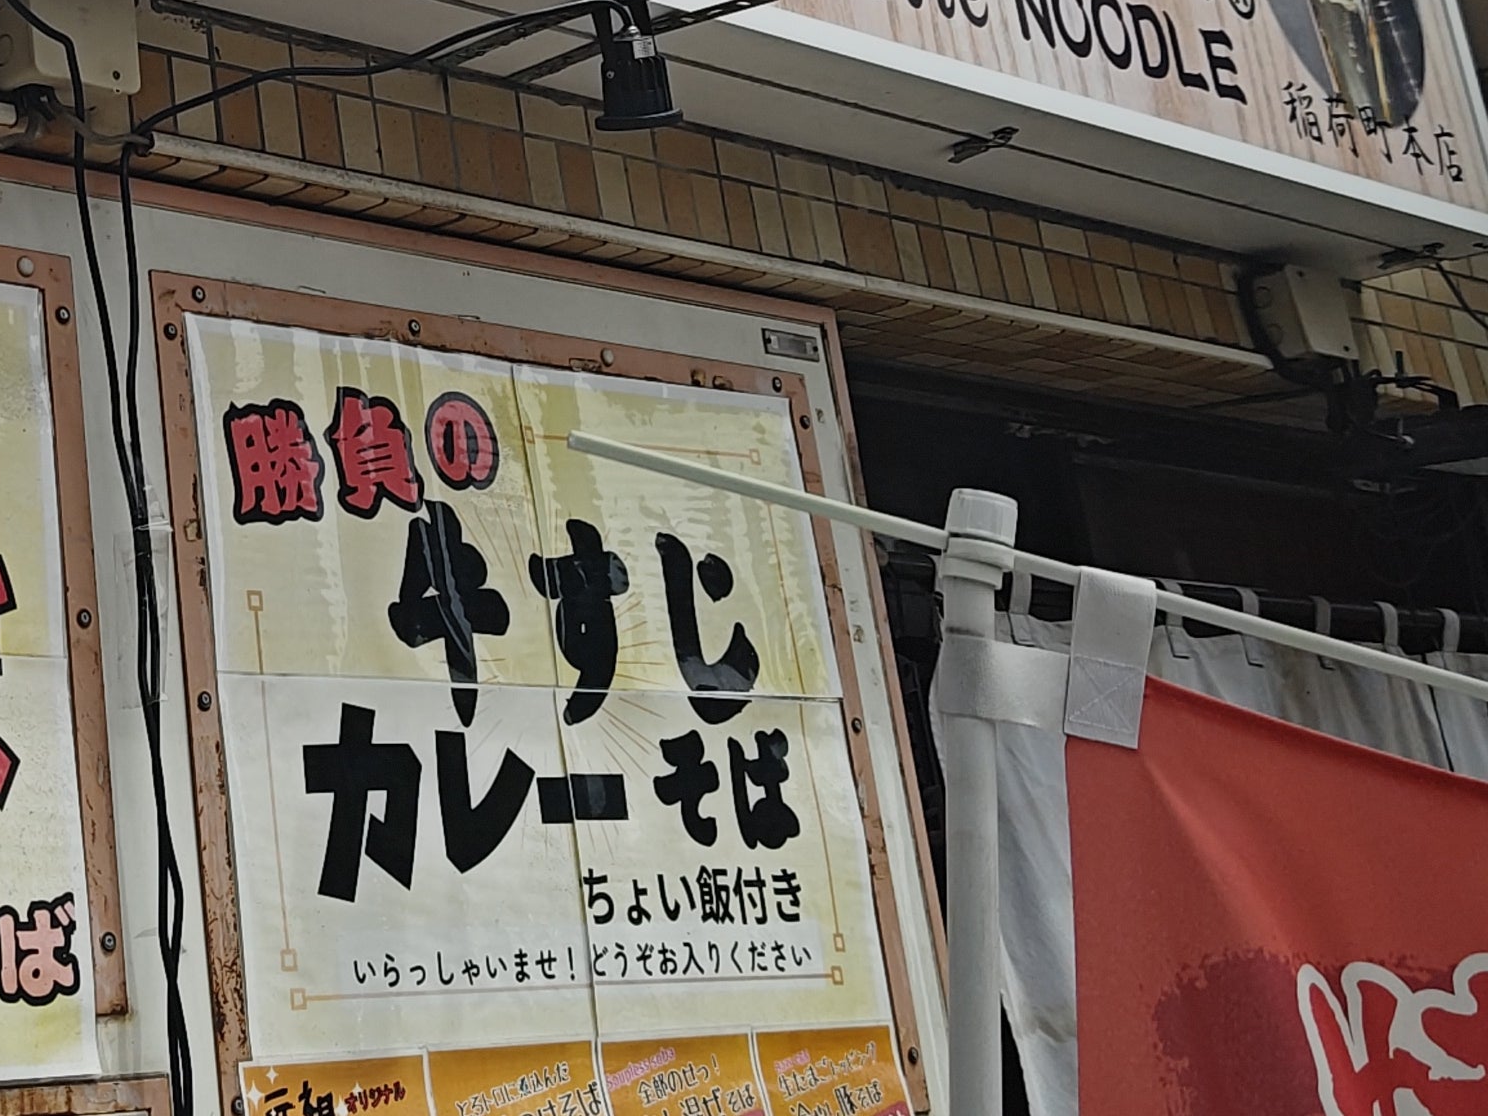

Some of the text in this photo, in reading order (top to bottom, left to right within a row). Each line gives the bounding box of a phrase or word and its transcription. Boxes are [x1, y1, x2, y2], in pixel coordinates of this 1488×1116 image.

[1281, 81, 1464, 183] 稲荷町本店
[223, 387, 499, 525] 勝負の
[388, 498, 761, 728] 牛すじ
[302, 703, 801, 903] カレーそば
[583, 867, 803, 925] ちょい飯付き
